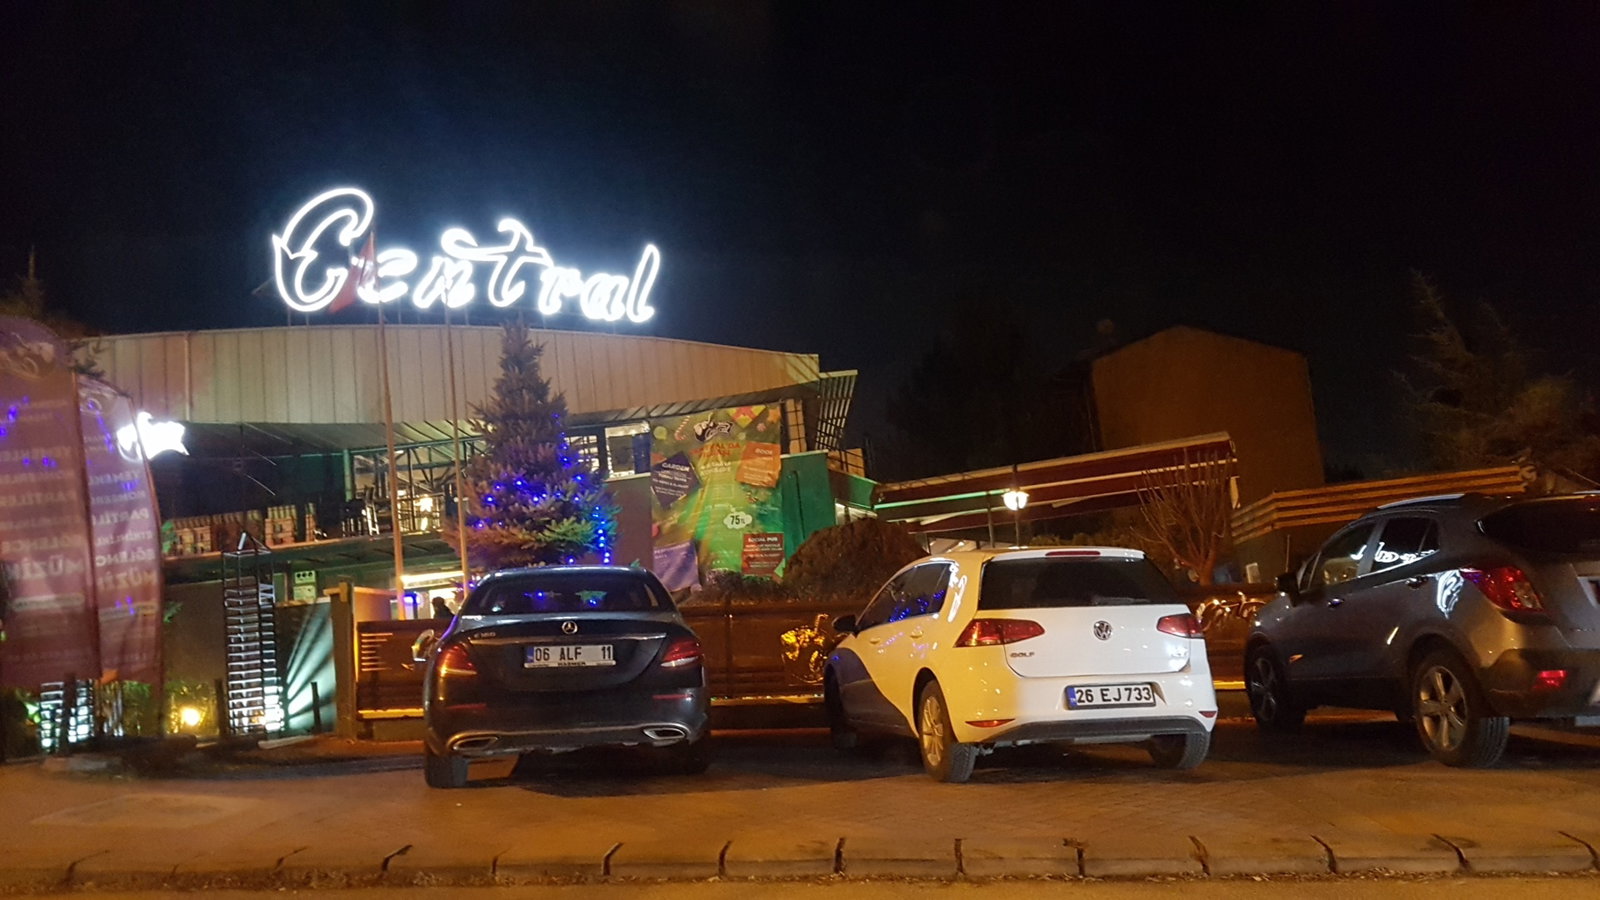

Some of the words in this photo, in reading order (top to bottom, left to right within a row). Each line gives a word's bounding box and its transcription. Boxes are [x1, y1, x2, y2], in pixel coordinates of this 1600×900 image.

[271, 186, 660, 323] Central
[661, 462, 690, 472] GARDEN
[730, 515, 740, 525] 75
[535, 647, 550, 661] 06
[559, 646, 582, 661] ALF
[601, 646, 612, 660] 11
[1076, 688, 1094, 704] 26
[1100, 687, 1122, 703] EJ
[1126, 686, 1152, 702] 733
